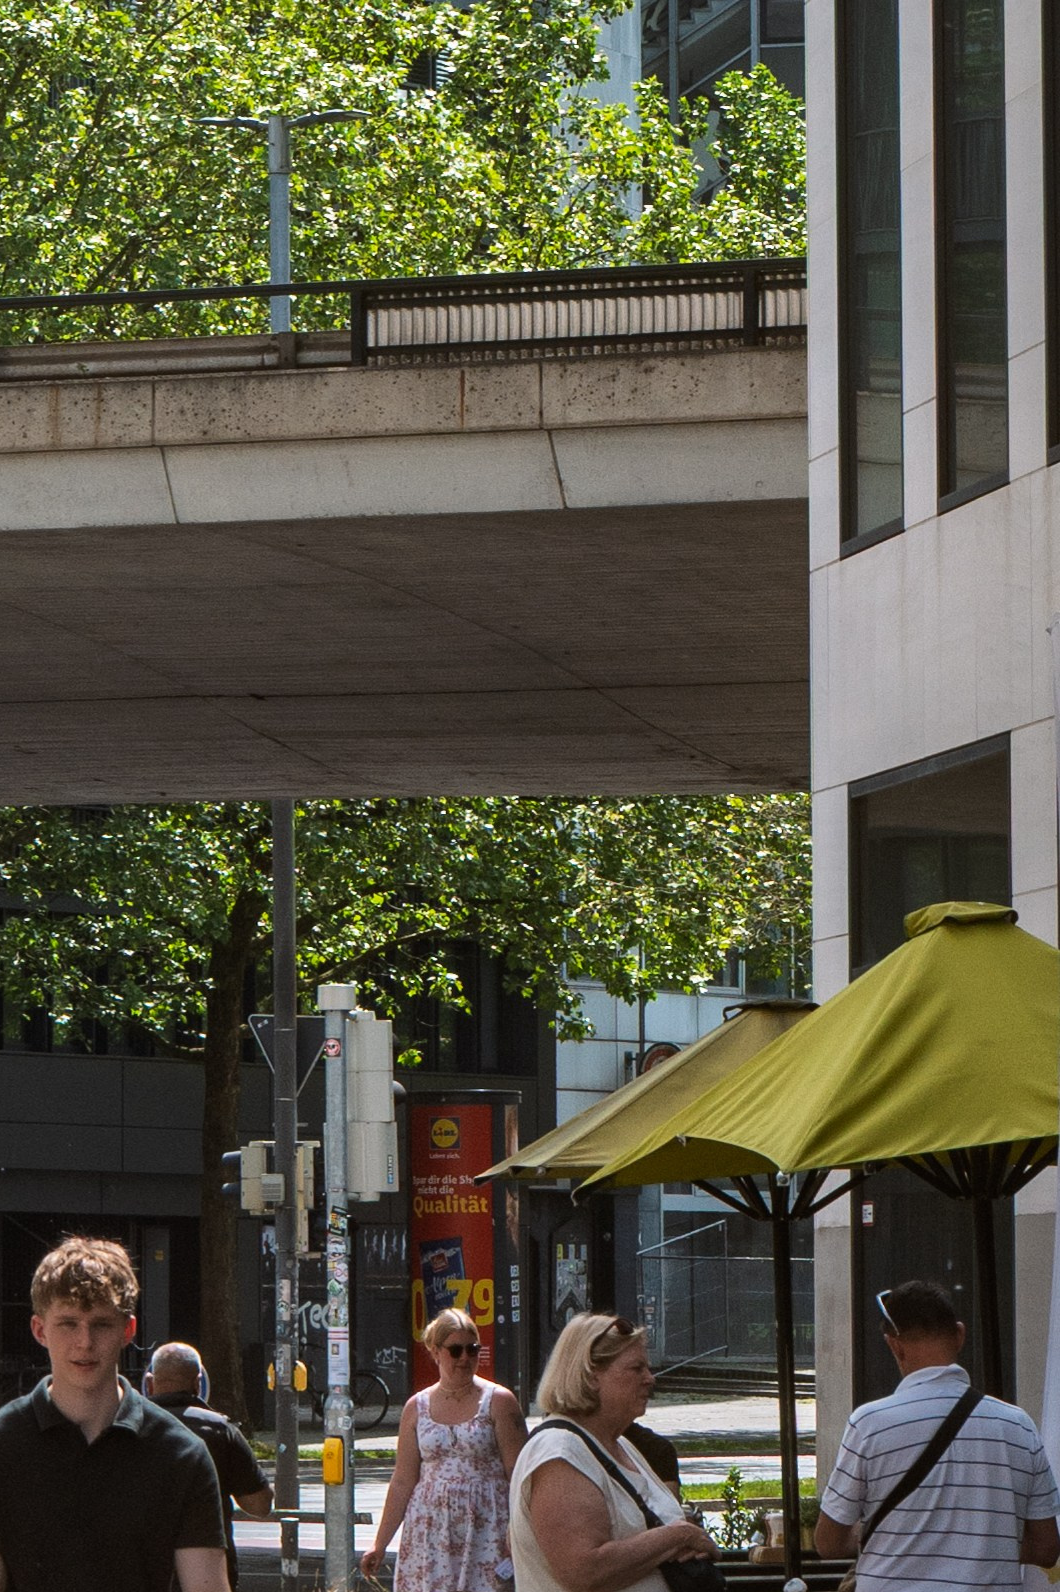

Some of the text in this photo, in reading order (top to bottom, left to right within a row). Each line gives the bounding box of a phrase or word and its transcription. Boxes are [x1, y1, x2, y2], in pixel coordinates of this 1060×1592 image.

[442, 1175, 458, 1184] die
[439, 1185, 455, 1194] die
[413, 1195, 488, 1218] Qualität
